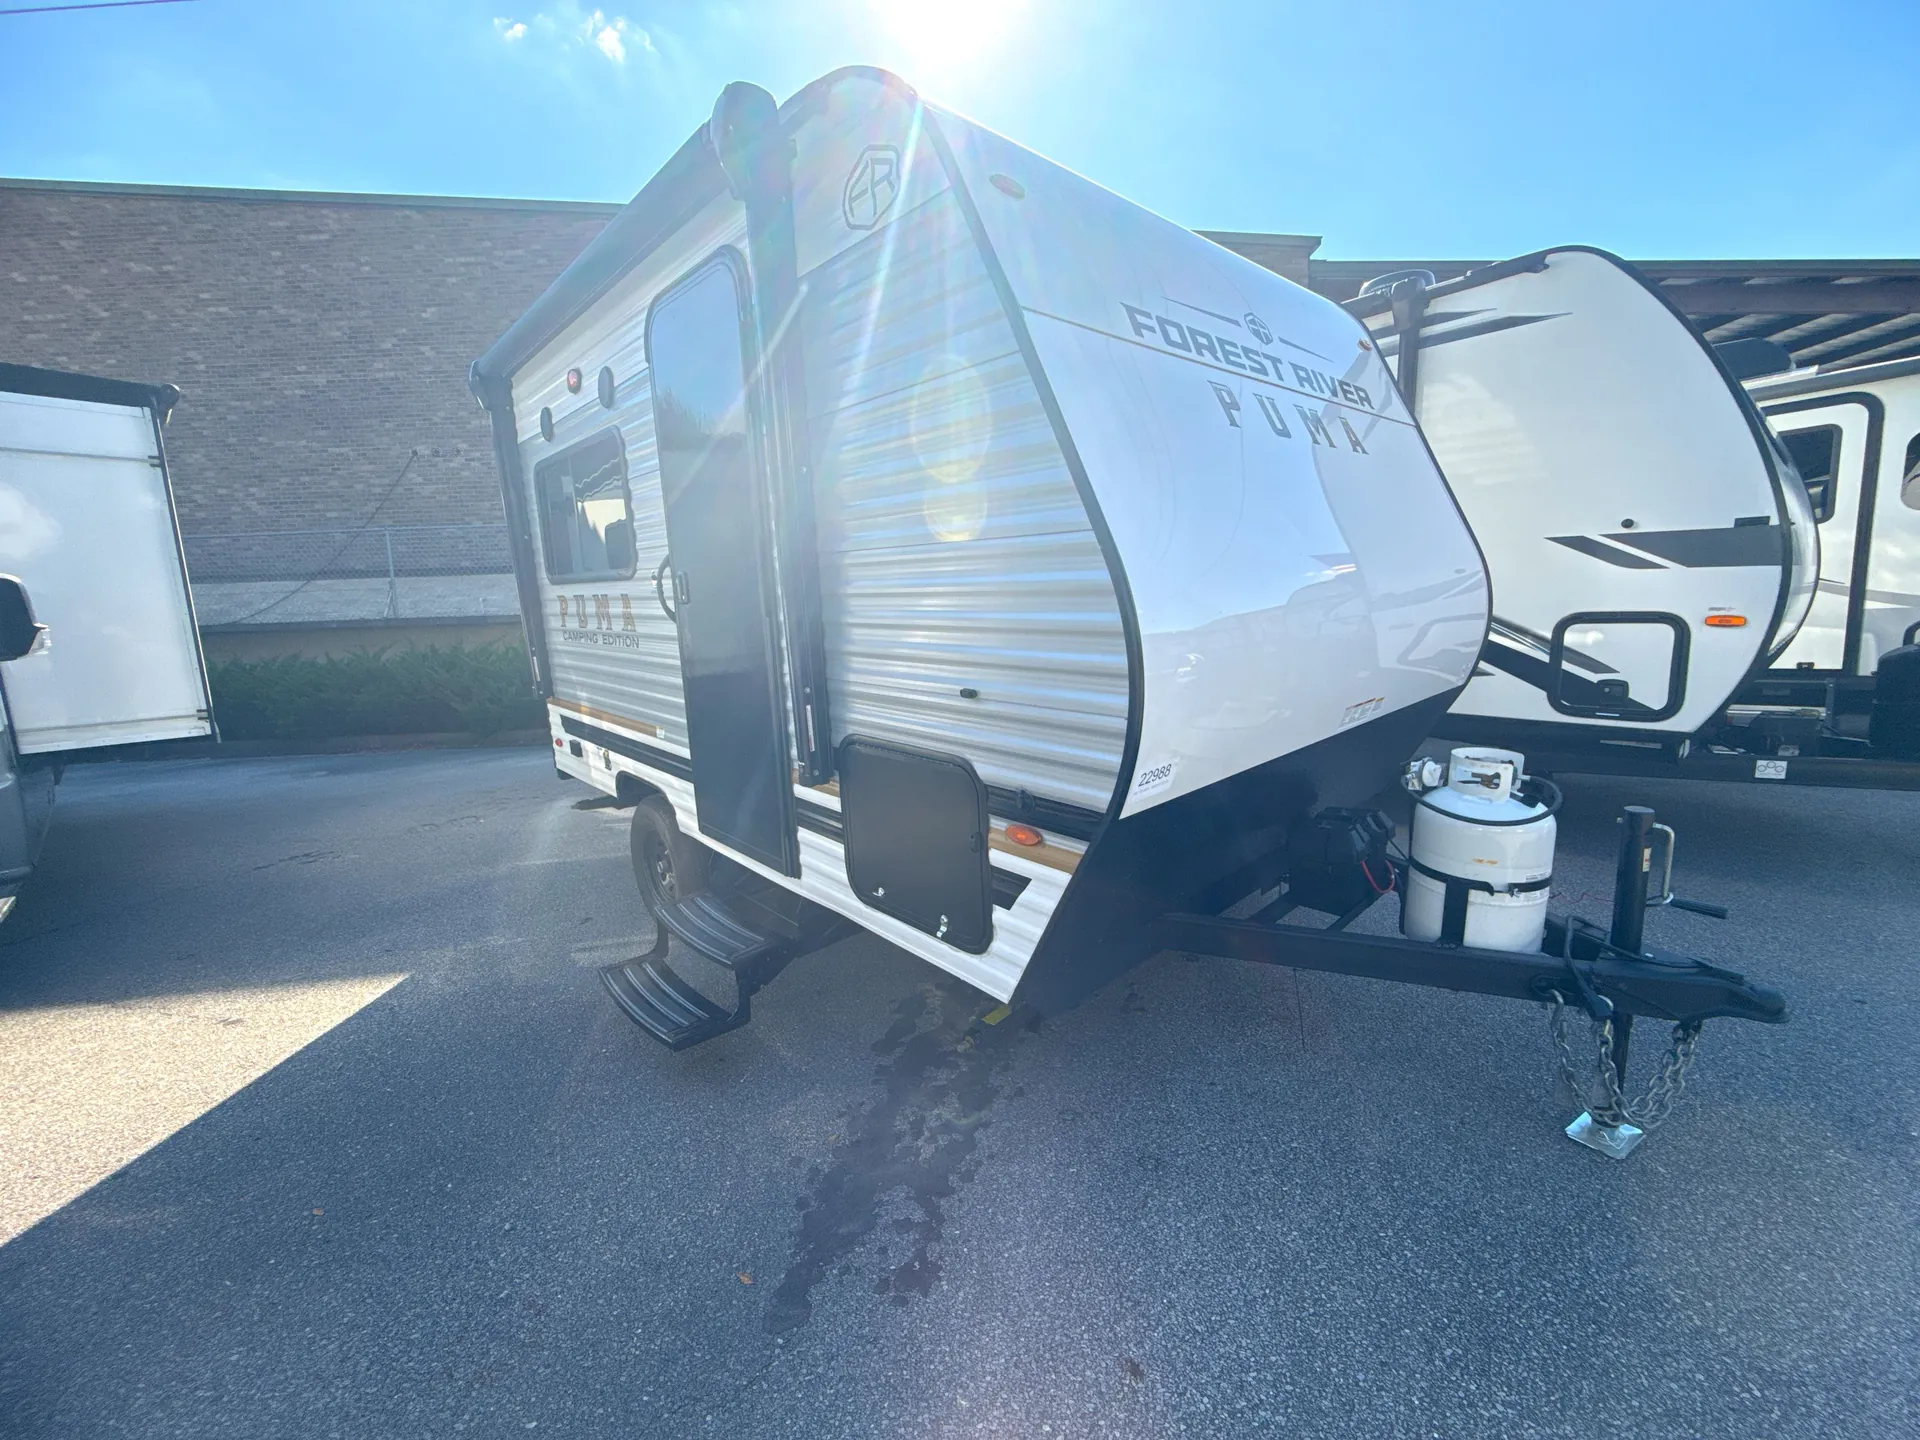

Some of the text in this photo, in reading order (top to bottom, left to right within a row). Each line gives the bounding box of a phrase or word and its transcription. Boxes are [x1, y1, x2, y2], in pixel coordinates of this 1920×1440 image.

[1119, 302, 1375, 410] FOREST RIVER
[1207, 380, 1369, 455] PUMA
[557, 593, 636, 632] PUMA
[563, 631, 640, 649] CAMPING EDITION
[1138, 763, 1172, 787] 22988
